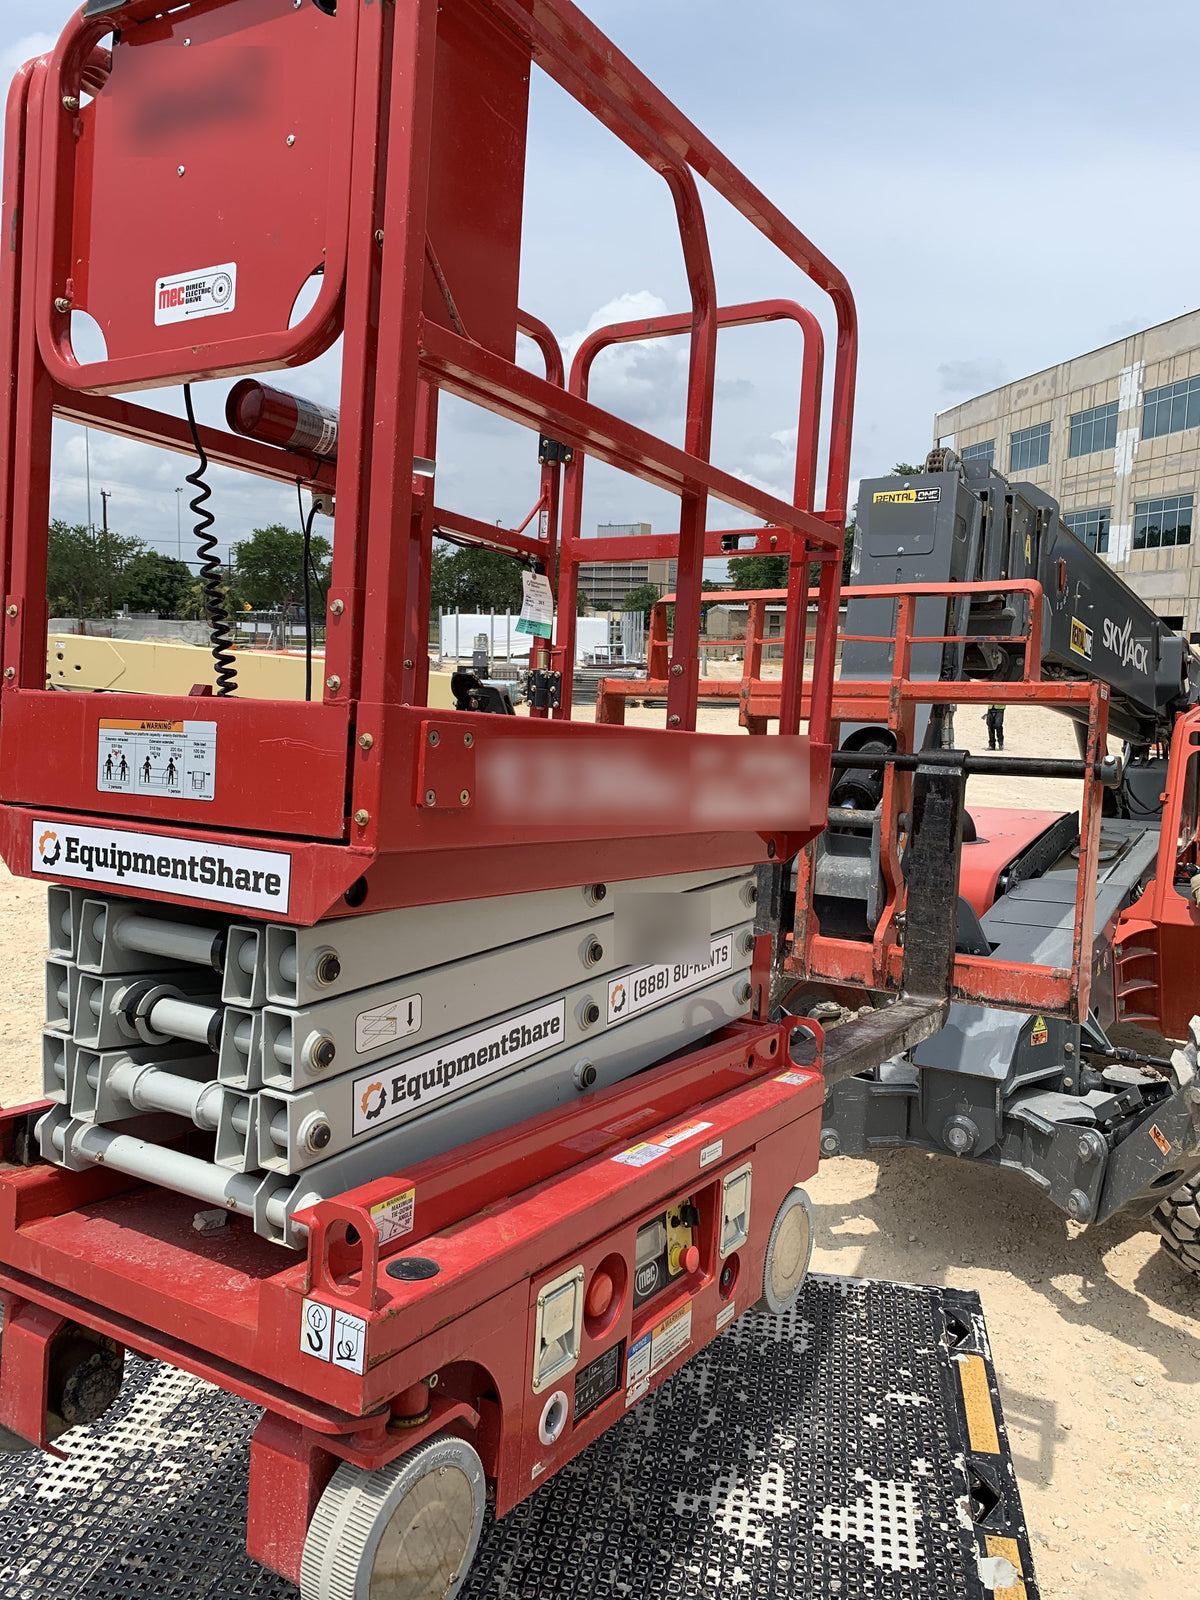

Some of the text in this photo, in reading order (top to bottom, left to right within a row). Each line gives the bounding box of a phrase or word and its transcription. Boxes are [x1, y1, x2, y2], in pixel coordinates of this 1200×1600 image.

[186, 282, 206, 292] DIRECT
[186, 287, 211, 298] ELECTRIC
[185, 296, 202, 304] DRIVE
[876, 490, 938, 503] RENTAL ONE
[1102, 617, 1148, 675] SKYJACK
[64, 836, 282, 896] EquipmentShare
[634, 968, 669, 1002] (888)
[391, 1016, 560, 1104] EquipmentShare
[387, 1193, 407, 1206] WARNING
[392, 1197, 413, 1211] MAXIMUM
[392, 1204, 412, 1218] TIE-DOWN
[398, 1212, 412, 1220] ANGLE
[666, 1307, 685, 1328] WARNING
[632, 1336, 648, 1352] NOTICE
